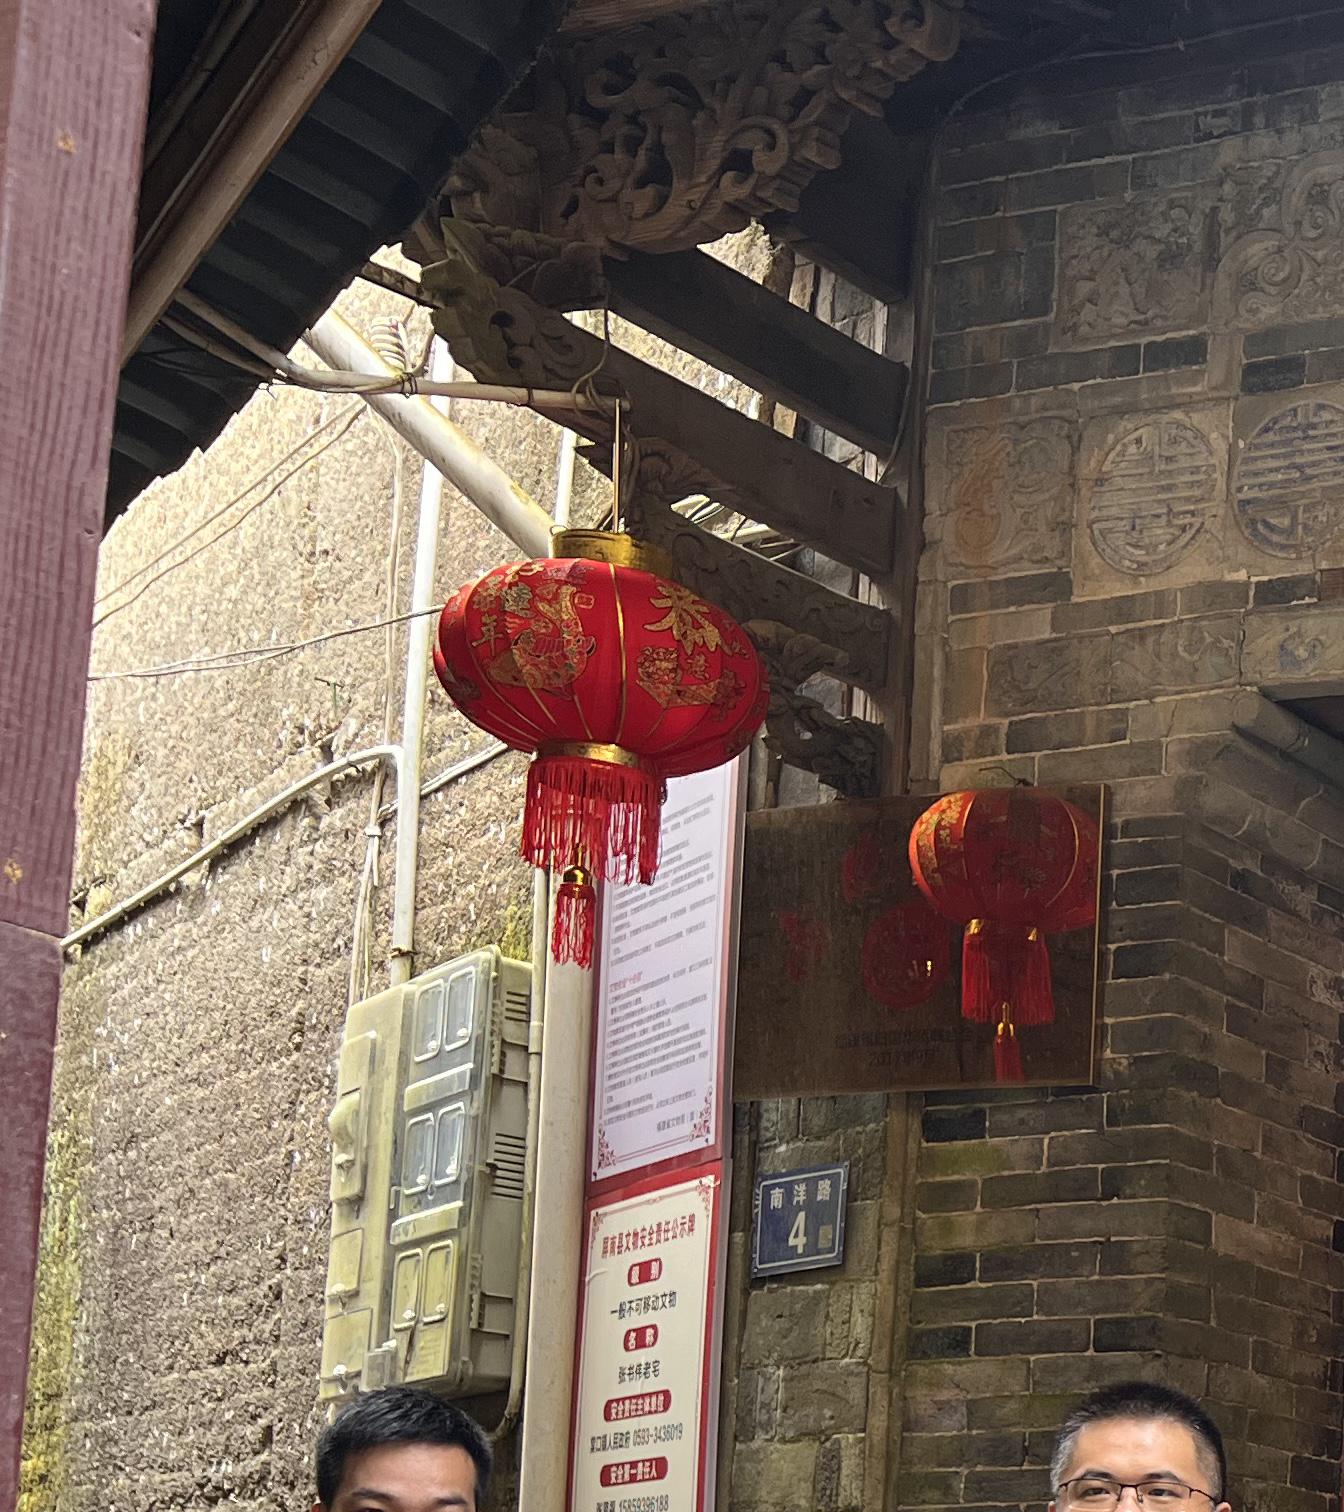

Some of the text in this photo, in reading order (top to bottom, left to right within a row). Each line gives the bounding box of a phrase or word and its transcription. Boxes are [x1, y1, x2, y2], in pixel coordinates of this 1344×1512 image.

[770, 1179, 832, 1210] 南洋路
[601, 1213, 696, 1259] 屏南县文物安全责任公示牌
[788, 1210, 808, 1254] 4
[610, 1291, 678, 1320] 一般不可移动文物
[610, 1460, 659, 1485] 安全第一责任人
